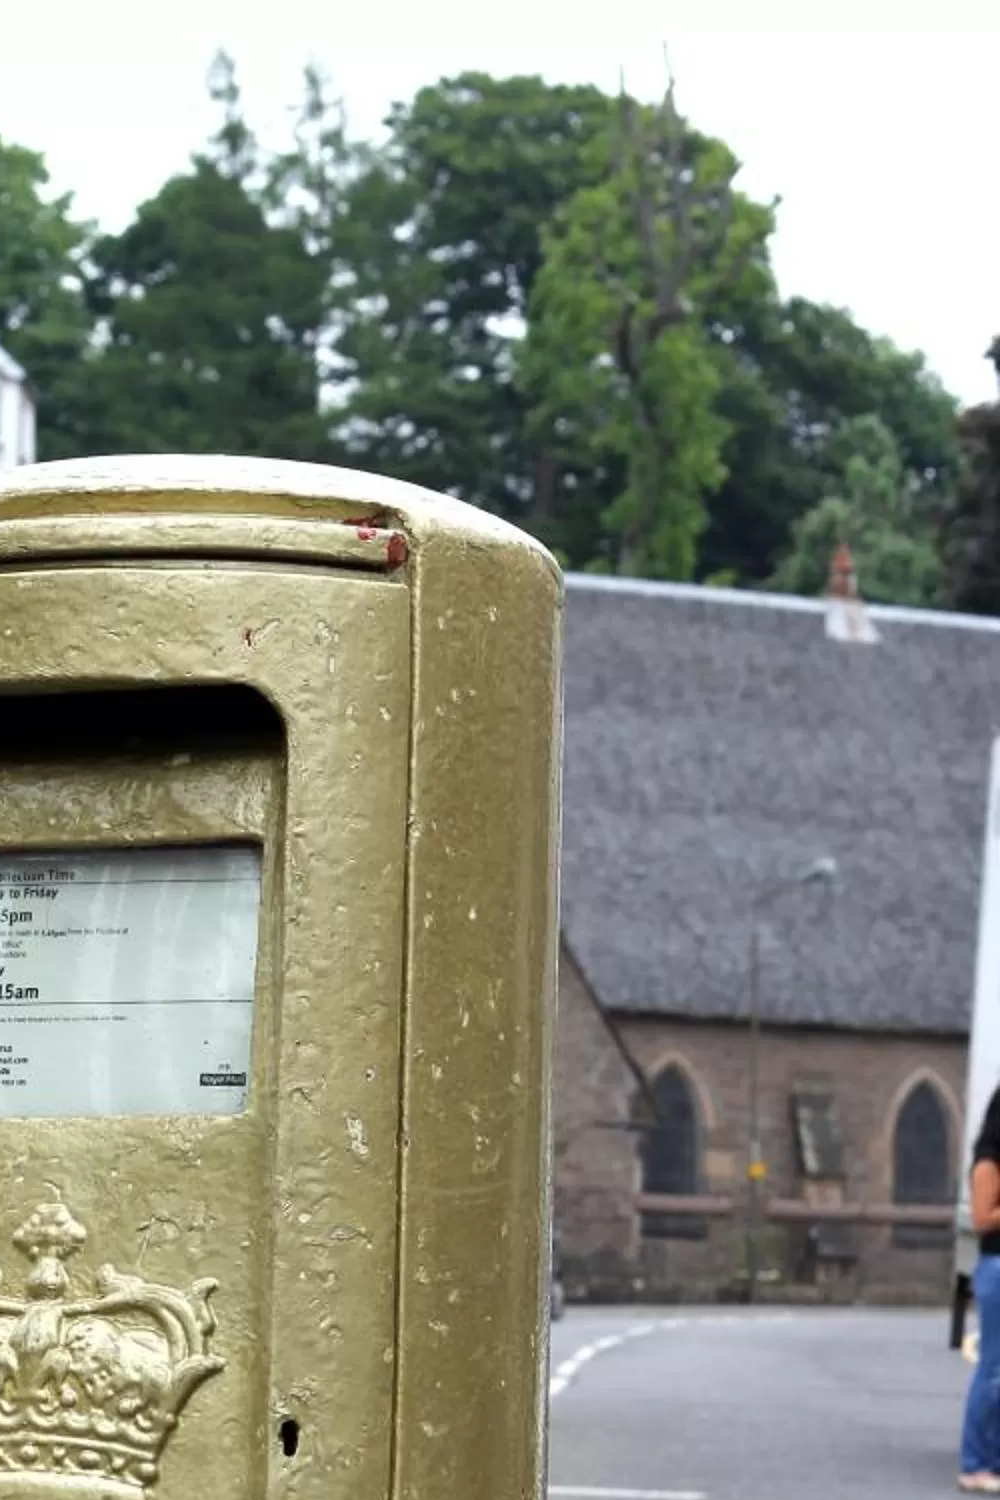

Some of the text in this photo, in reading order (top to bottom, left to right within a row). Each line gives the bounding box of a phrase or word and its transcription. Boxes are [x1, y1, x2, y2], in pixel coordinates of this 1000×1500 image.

[48, 868, 76, 881] Time
[10, 888, 21, 900] to
[23, 886, 59, 901] Friday
